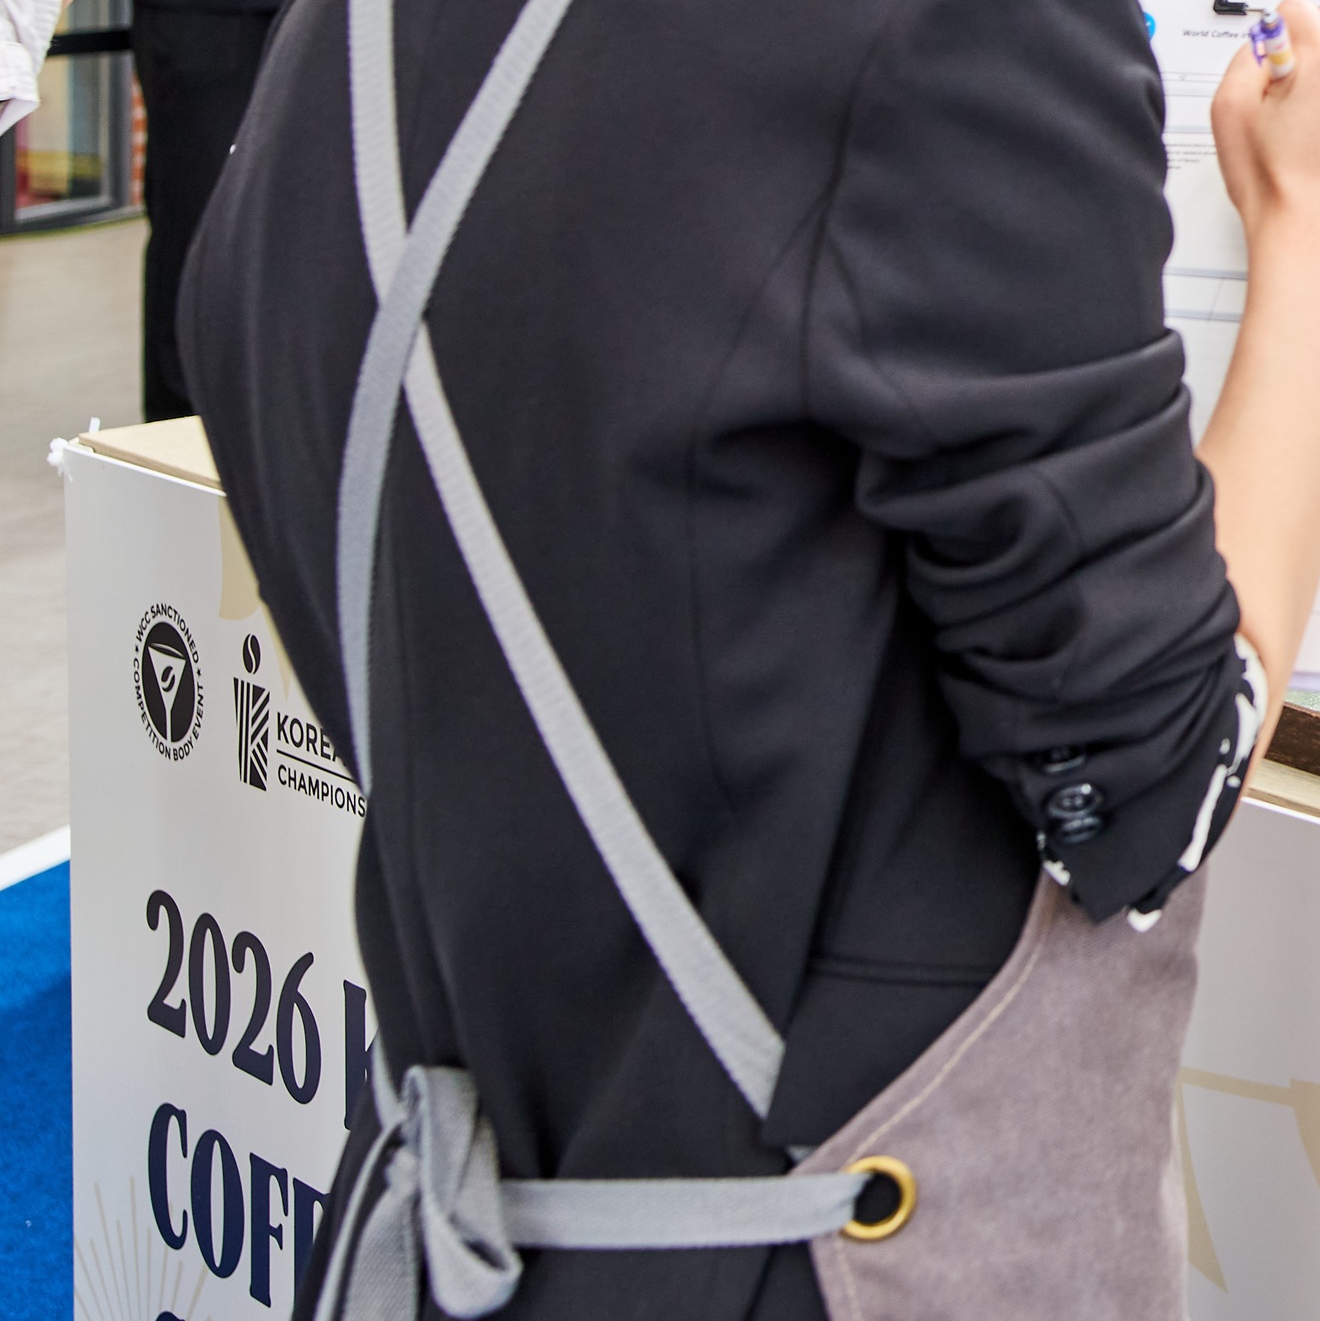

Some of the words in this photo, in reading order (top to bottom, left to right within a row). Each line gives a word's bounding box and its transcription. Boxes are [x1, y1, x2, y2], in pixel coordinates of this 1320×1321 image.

[1182, 29, 1210, 38] World
[1211, 29, 1239, 39] Coffee
[136, 611, 151, 644] WCC
[150, 602, 200, 664] SANCTIONED
[133, 657, 171, 760] COMPETITION
[173, 738, 194, 762] BODY
[192, 683, 204, 740] EVENT
[277, 763, 367, 818] CHAMPIONS
[145, 889, 322, 1105] 2026
